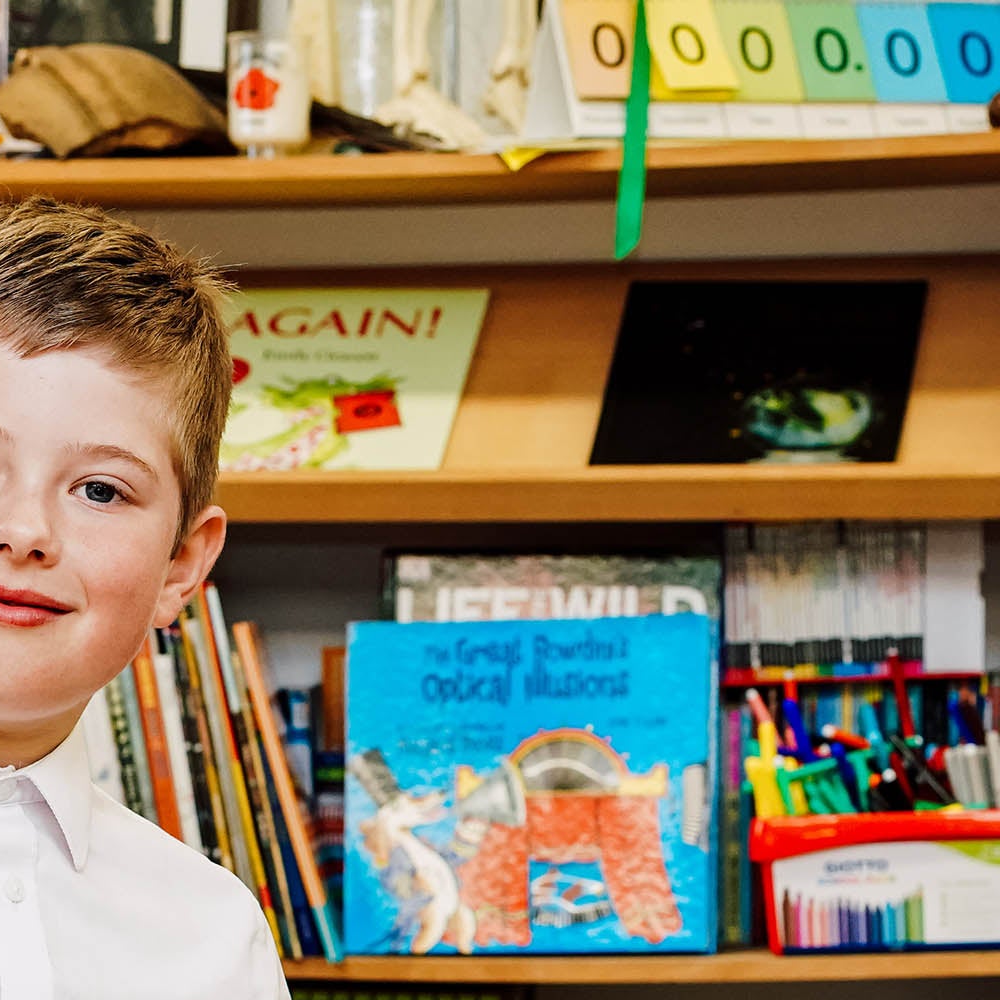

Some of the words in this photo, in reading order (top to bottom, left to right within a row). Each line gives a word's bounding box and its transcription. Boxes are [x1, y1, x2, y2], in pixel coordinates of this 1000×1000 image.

[592, 23, 625, 67] 0
[670, 23, 705, 65] 0
[740, 26, 773, 73] 0
[886, 29, 920, 77] 0
[959, 31, 993, 77] 0
[230, 305, 443, 339] AGAIN!
[421, 664, 512, 705] Optical
